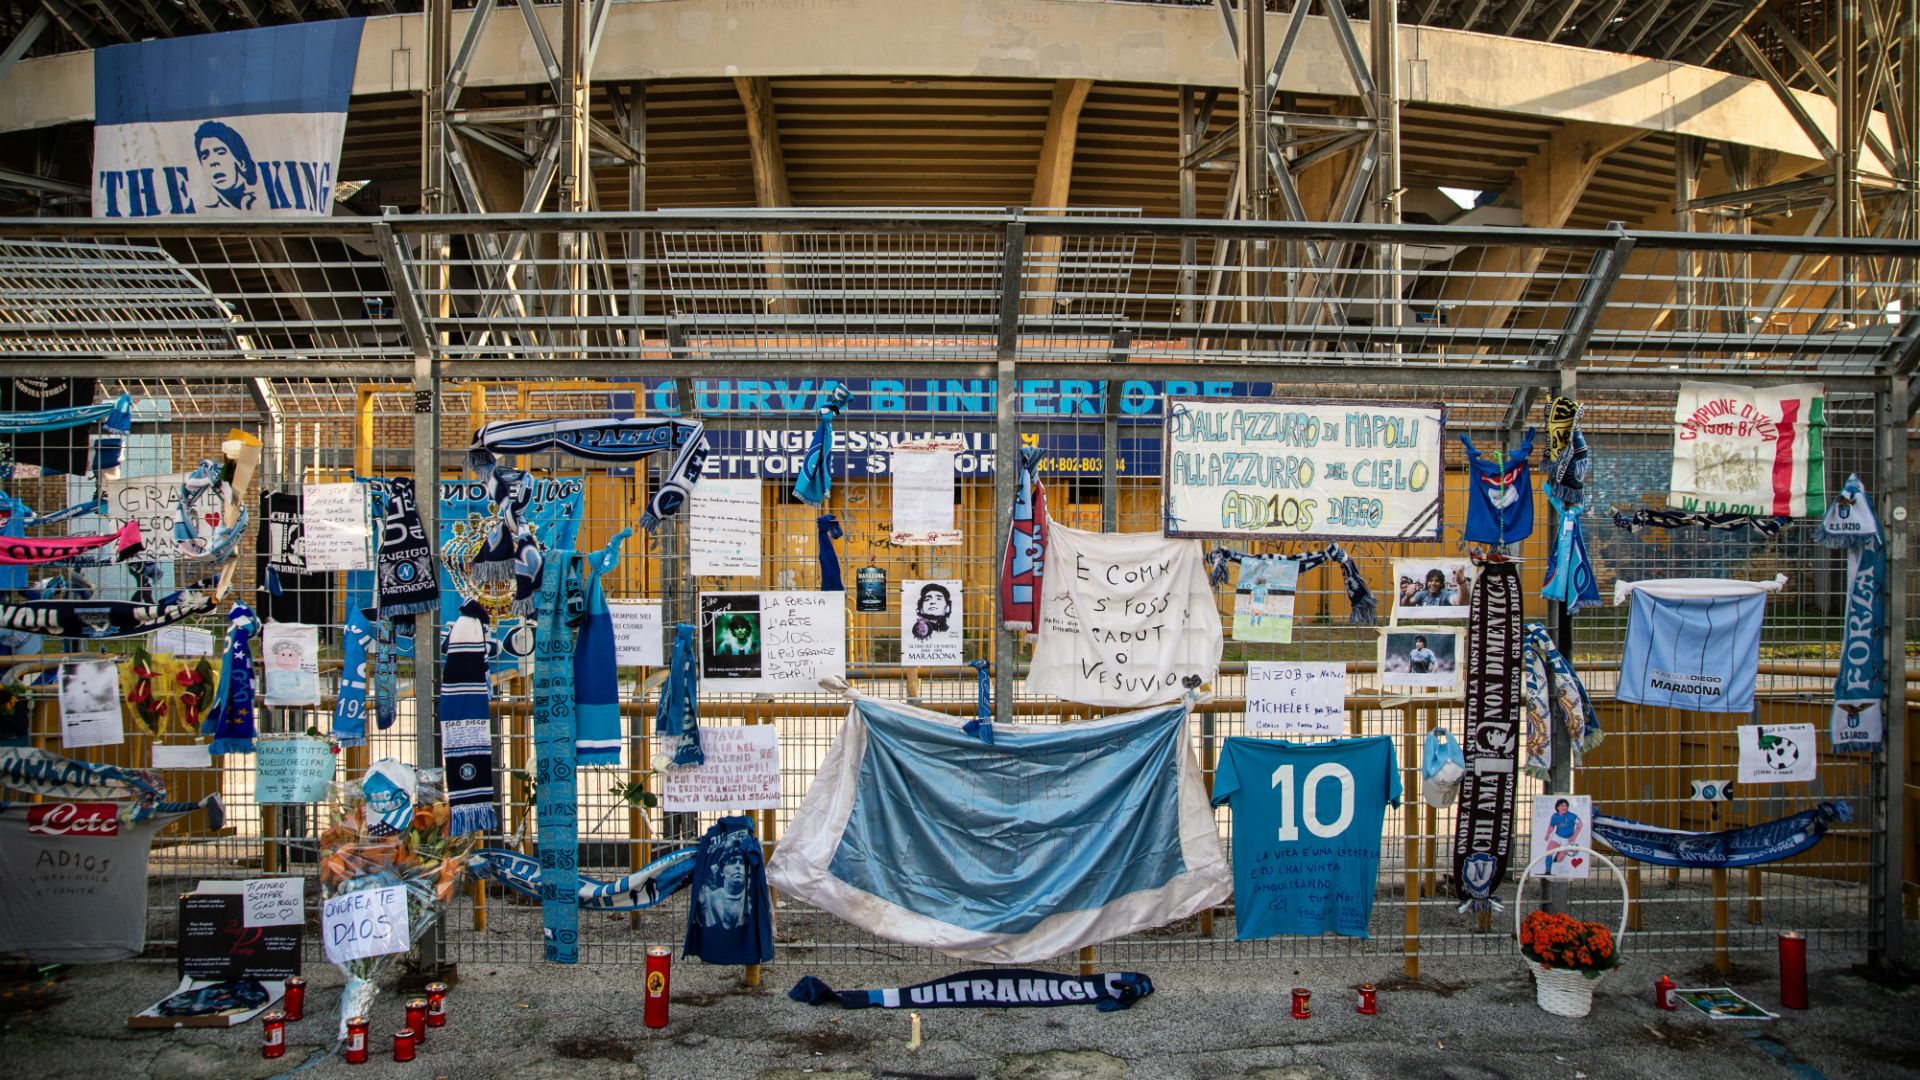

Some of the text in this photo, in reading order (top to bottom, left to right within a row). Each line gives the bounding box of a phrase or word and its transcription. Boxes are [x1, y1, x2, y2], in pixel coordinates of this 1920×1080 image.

[100, 161, 331, 217] THE KING
[870, 380, 896, 413] B
[580, 426, 672, 446] PAZZO
[1321, 422, 1339, 441] DI
[1345, 411, 1419, 449] NAPOLI
[1679, 398, 1738, 441] CAMPIONE
[1352, 458, 1430, 492] CIELO
[118, 484, 219, 512] GRAIE
[1327, 496, 1384, 529] DIEGO
[1682, 496, 1699, 512] W
[1506, 574, 1521, 612] DIEGO
[788, 609, 797, 617] E
[1847, 564, 1875, 691] FORZA
[797, 648, 837, 657] GRANDE
[1470, 624, 1480, 675] NOSTRA
[1483, 574, 1507, 720] NON DIMENTICA
[1511, 614, 1521, 660] GRAZIE
[908, 652, 957, 660] MARADONA
[1081, 657, 1178, 693] VESUVIO
[1469, 679, 1479, 694] LA
[1510, 665, 1520, 705] DIEGO
[1650, 678, 1721, 697] MARADONA
[1271, 762, 1355, 842] 10
[1503, 773, 1515, 808] DIEGO
[1471, 774, 1499, 853] CHI AMA
[1497, 808, 1511, 857] GRAZIE
[374, 888, 396, 907] TE
